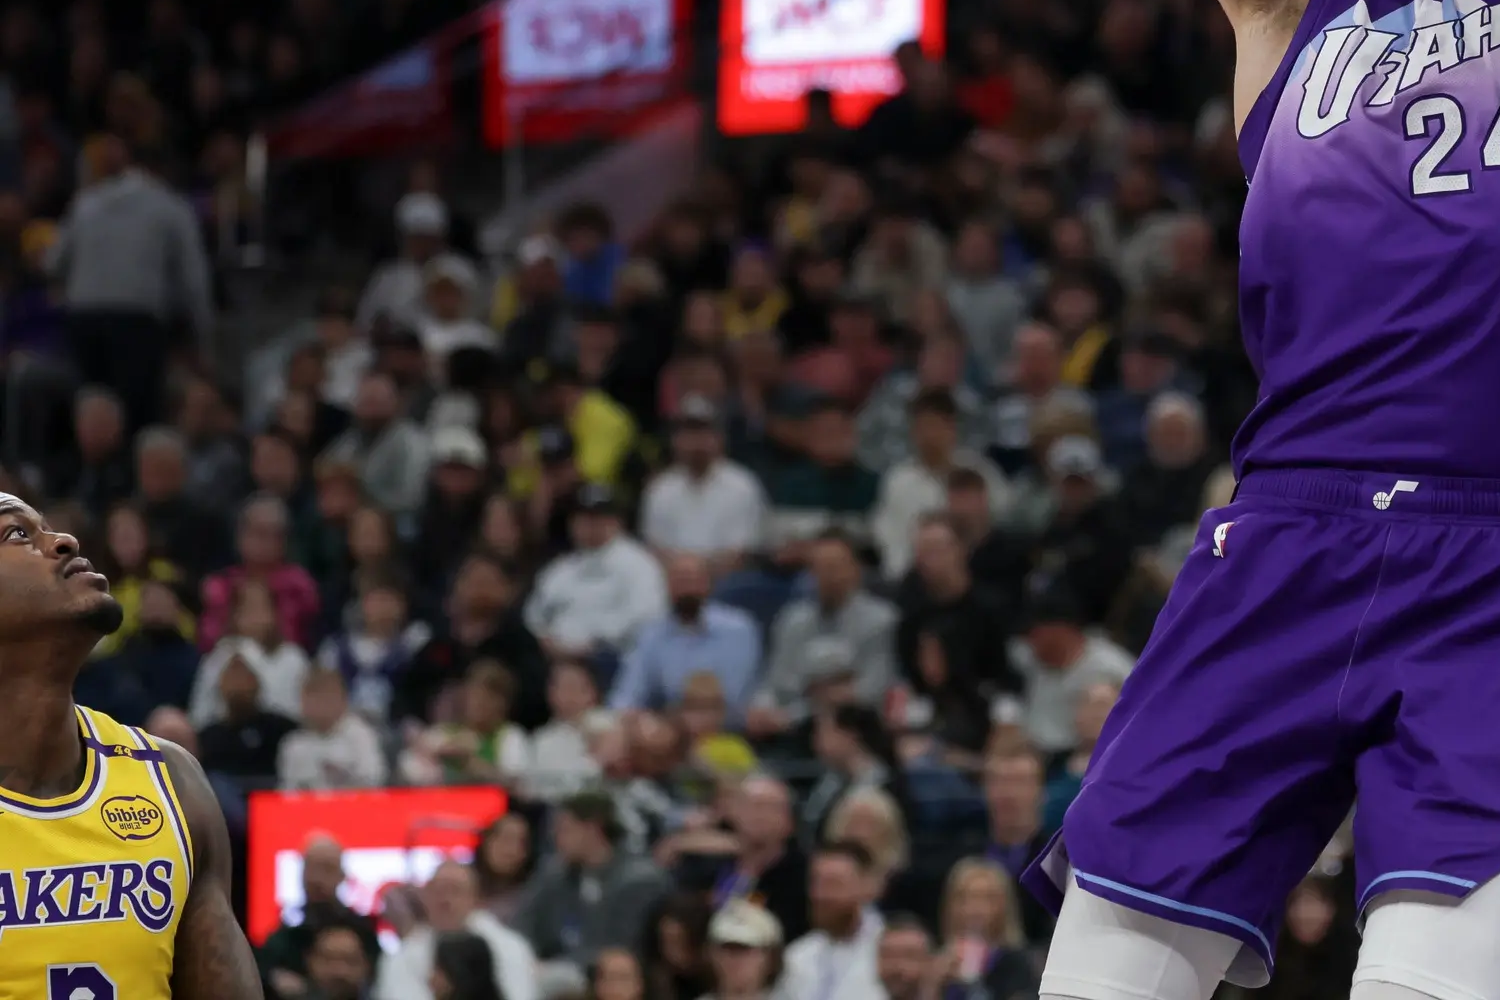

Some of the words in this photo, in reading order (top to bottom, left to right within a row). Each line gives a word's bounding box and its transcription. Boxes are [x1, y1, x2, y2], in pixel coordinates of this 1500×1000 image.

[113, 745, 133, 758] 44
[104, 806, 160, 826] bibigo
[0, 858, 175, 933] AKERS
